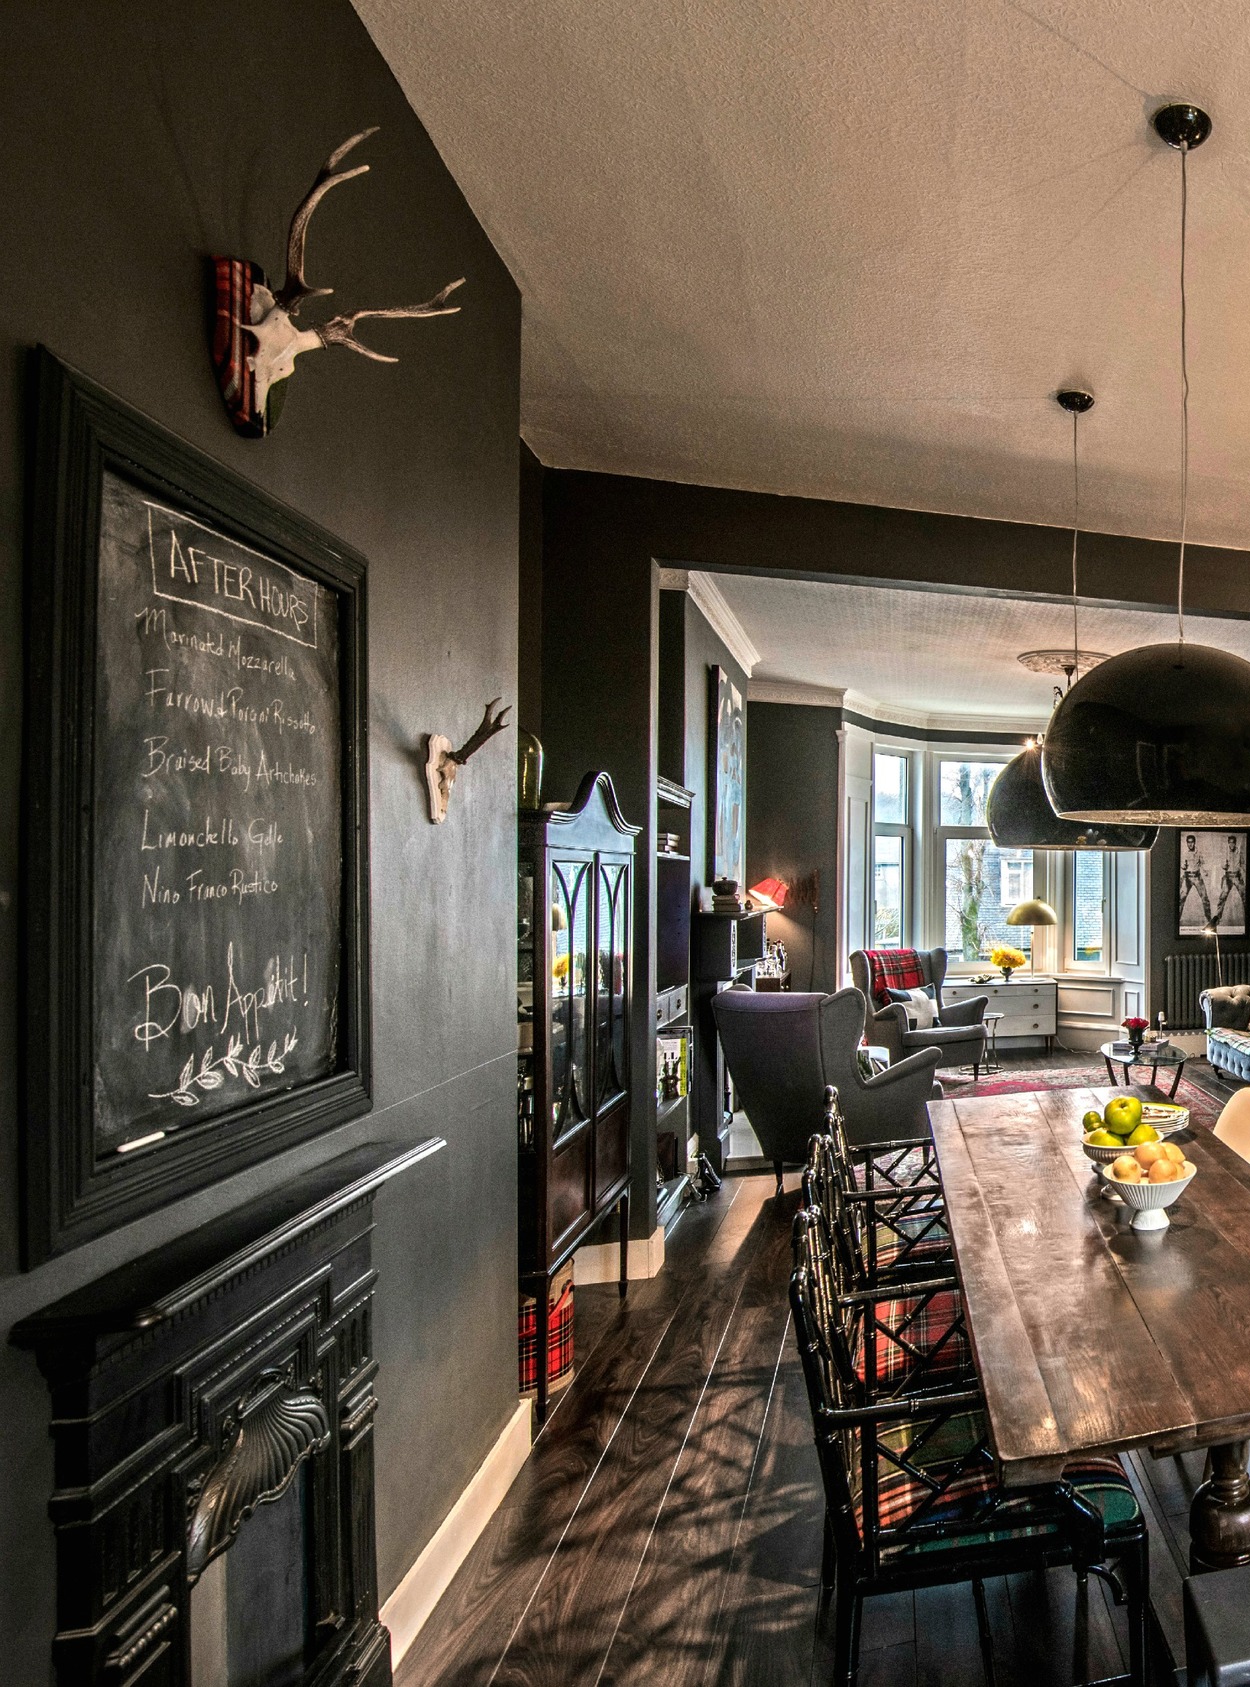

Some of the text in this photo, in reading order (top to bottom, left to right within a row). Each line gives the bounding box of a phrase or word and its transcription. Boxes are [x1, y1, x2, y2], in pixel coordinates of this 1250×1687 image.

[170, 529, 309, 632] AFTER HOURS
[228, 635, 296, 681] Mozzarella
[141, 735, 317, 792] Braised Baby Artichokes
[141, 809, 239, 850] Limonchello
[141, 866, 278, 909] Nino Franco Rustico
[127, 963, 218, 1052] Bon
